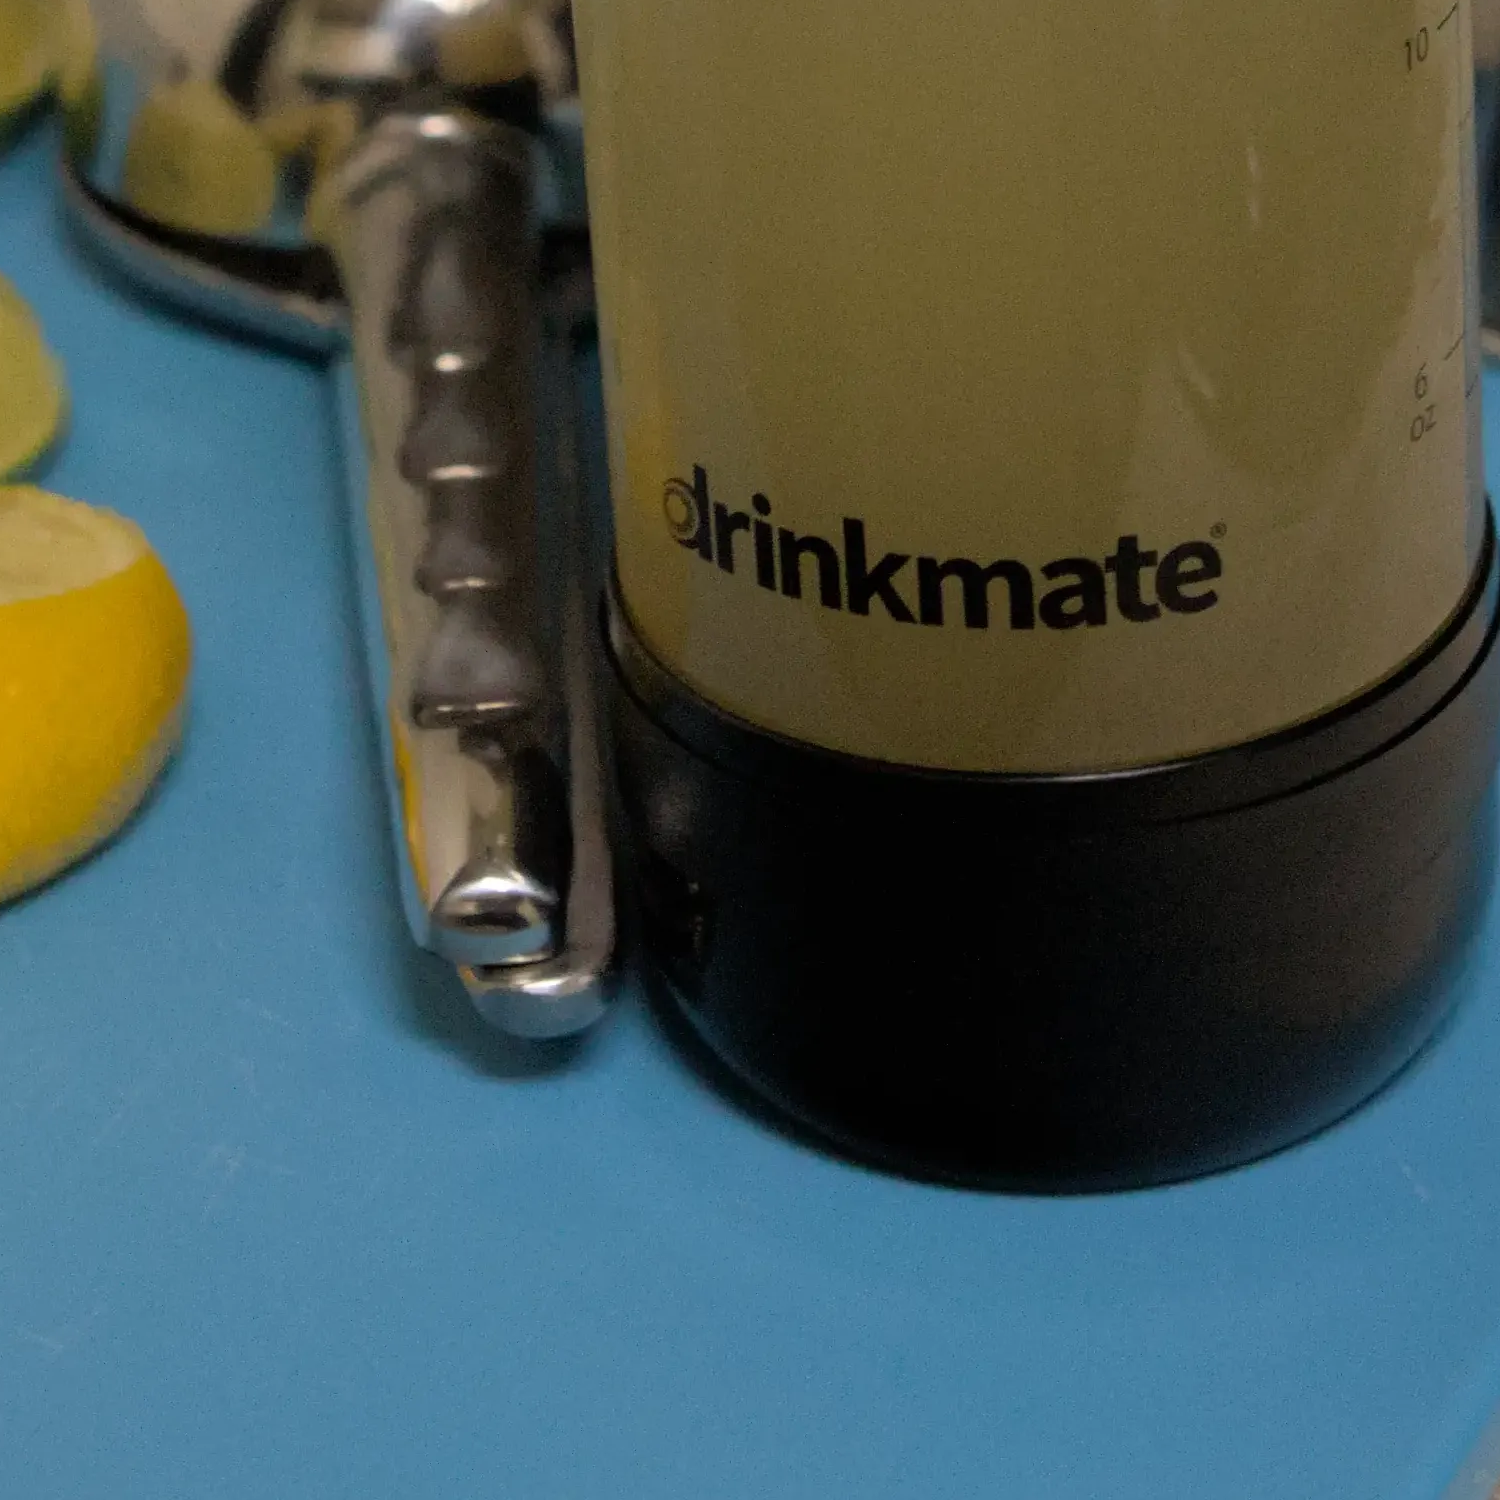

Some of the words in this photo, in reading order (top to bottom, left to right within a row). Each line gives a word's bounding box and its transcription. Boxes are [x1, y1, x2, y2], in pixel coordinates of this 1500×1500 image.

[1403, 24, 1430, 74] 10
[1412, 360, 1430, 401] 6
[662, 463, 1224, 632] drinkmate
